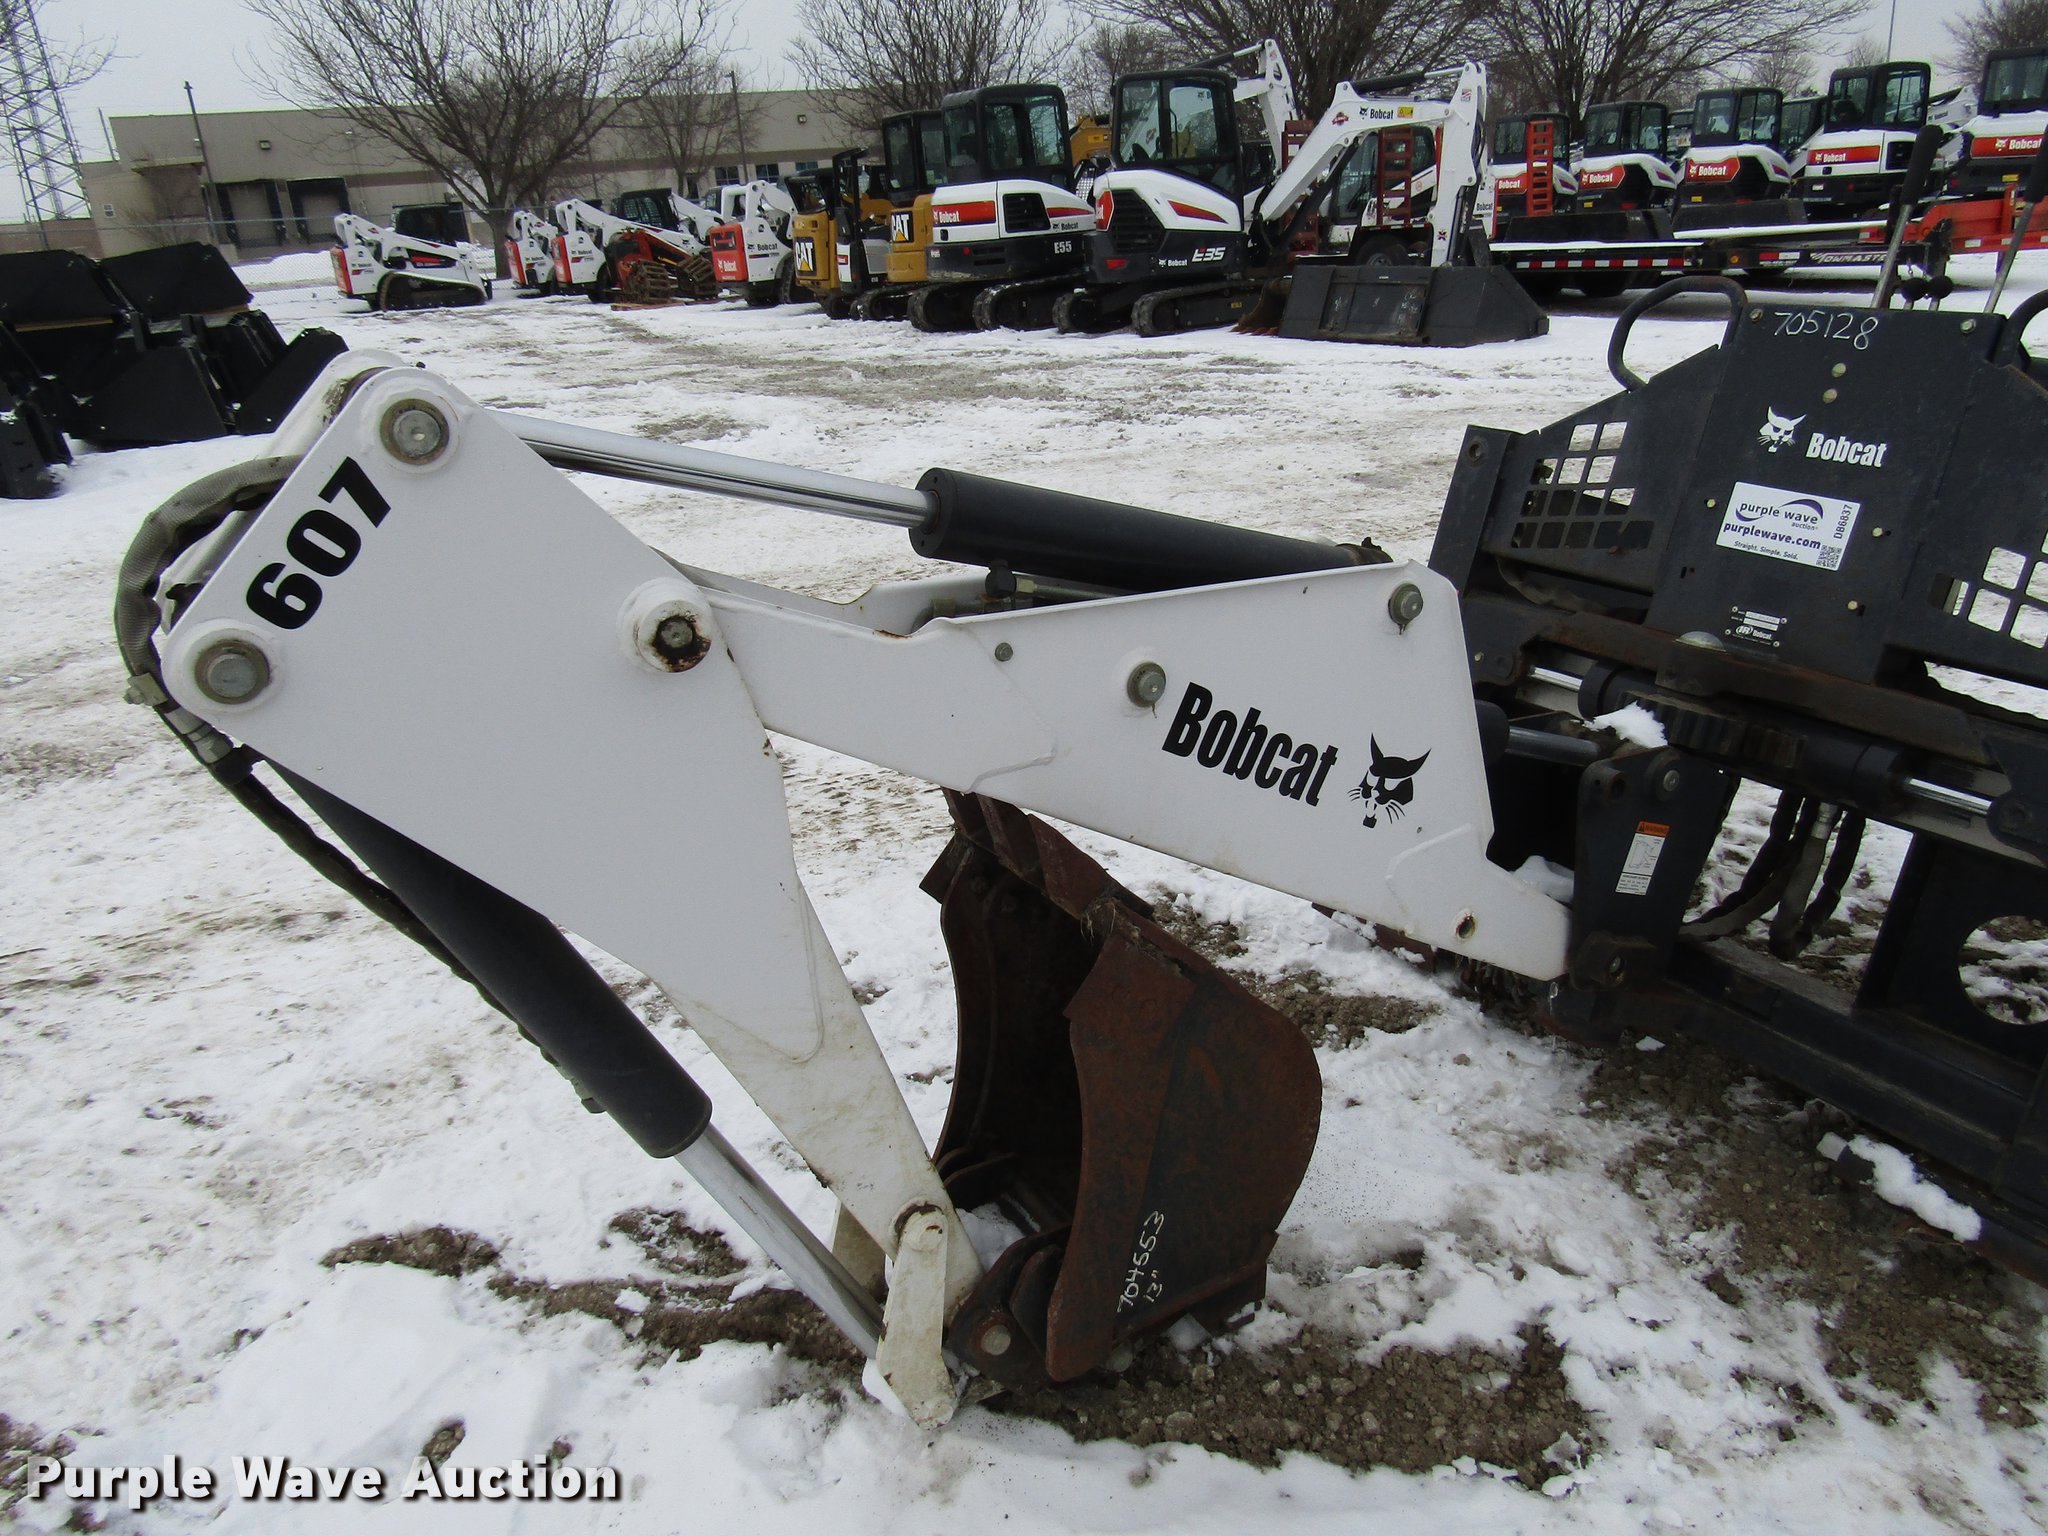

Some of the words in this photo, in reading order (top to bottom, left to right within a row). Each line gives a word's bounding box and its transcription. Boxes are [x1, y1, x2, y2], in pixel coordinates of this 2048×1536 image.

[1370, 108, 1394, 120] Bobcat
[1823, 153, 1847, 163] Bobcat
[1698, 165, 1727, 176] Bobcat
[1498, 180, 1520, 189] Bobcat
[1589, 173, 1613, 184] Bobcat
[939, 211, 960, 223] Bobcat
[1061, 222, 1079, 231] Bobcat
[757, 243, 778, 251] Bobcat
[1054, 241, 1072, 254] E55
[795, 242, 813, 271] CAT
[1192, 247, 1226, 262] E35
[1167, 259, 1188, 267] Bobcat
[1774, 310, 1879, 350] 705128
[1806, 432, 1887, 468] Bobcat
[1740, 502, 1780, 518] purple
[1784, 509, 1818, 524] wave
[1791, 521, 1816, 531] auction
[1833, 504, 1853, 540] DB6837
[1723, 522, 1821, 549] purplewave.com
[246, 456, 392, 630] 607
[1734, 540, 1758, 552] Straight.
[1760, 546, 1781, 558] Simple.
[1783, 551, 1799, 561] Sold.
[1162, 682, 1338, 807] Bobcat
